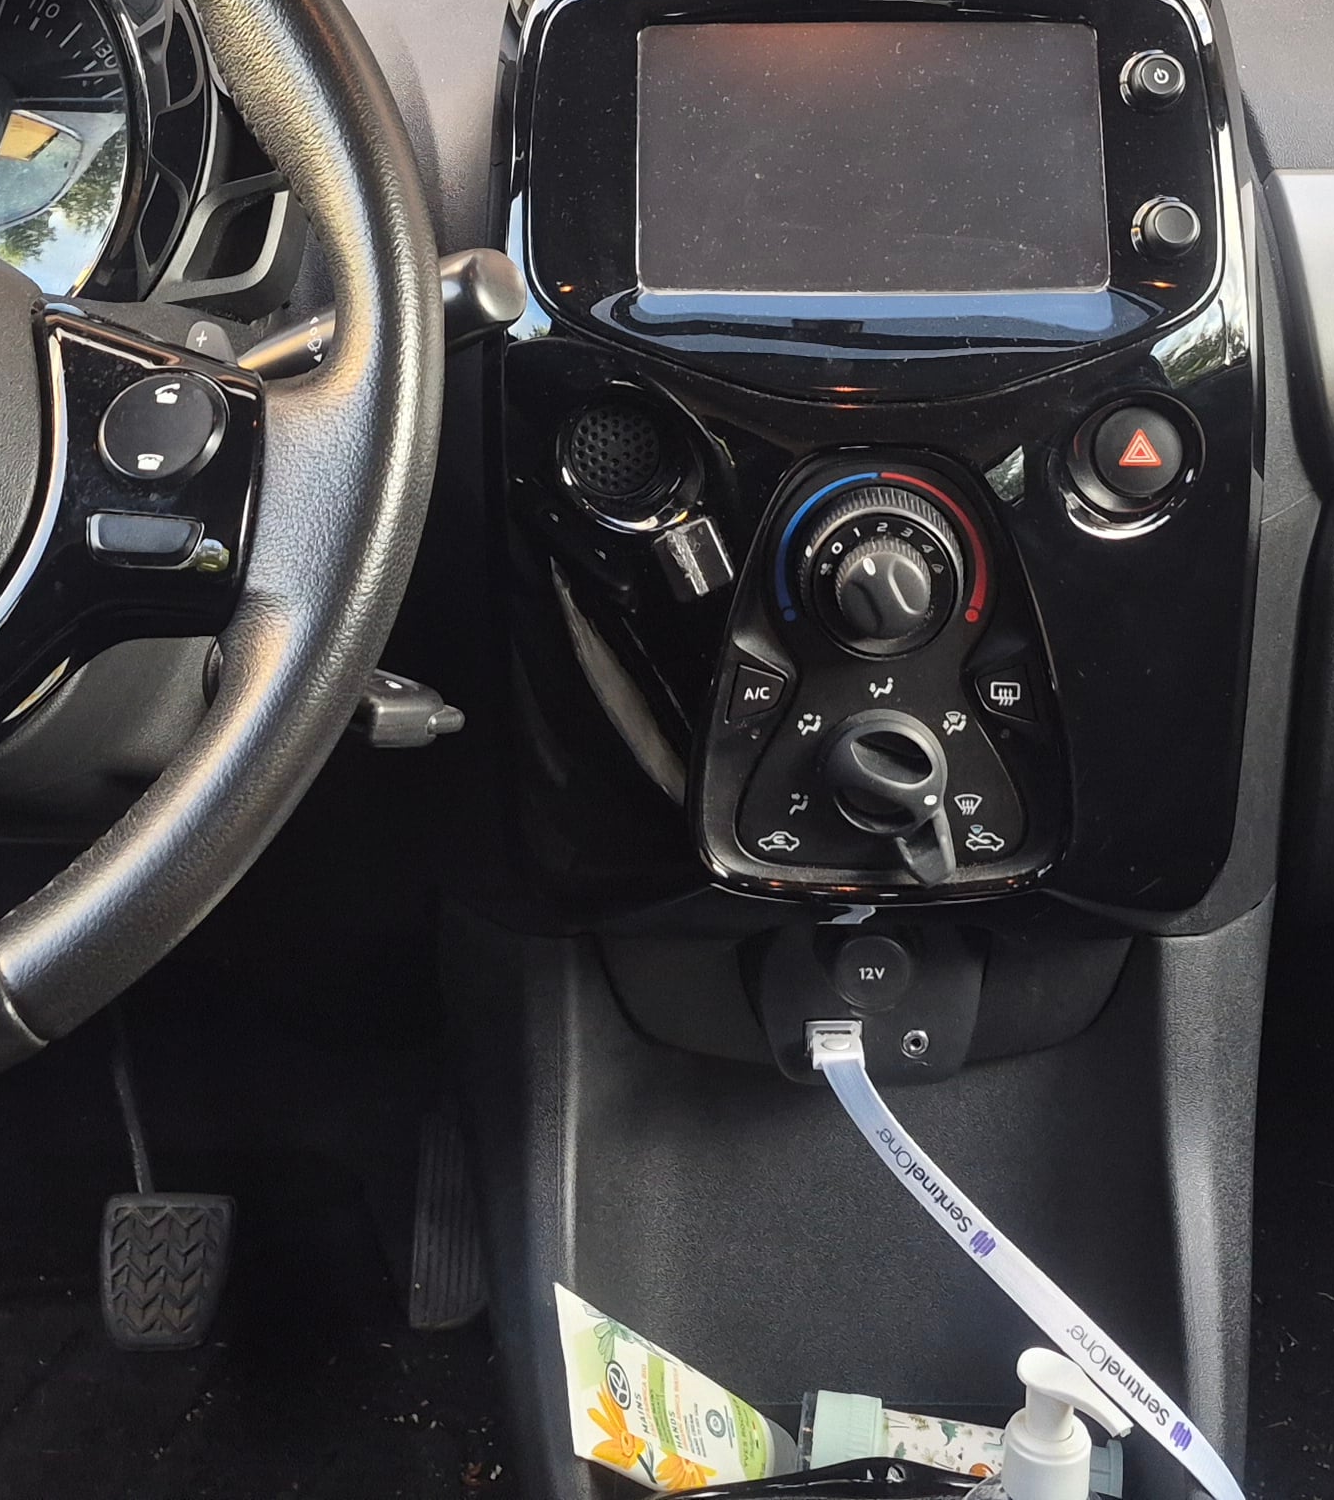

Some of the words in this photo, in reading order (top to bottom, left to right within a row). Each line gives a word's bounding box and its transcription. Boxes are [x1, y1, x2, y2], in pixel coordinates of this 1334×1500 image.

[91, 37, 117, 68] 130
[853, 527, 861, 537] 1
[876, 522, 888, 532] 2
[900, 527, 913, 538] 3
[831, 541, 843, 555] 0
[922, 544, 934, 554] 4
[744, 686, 771, 701] A/C
[858, 966, 886, 980] 12V
[877, 1128, 973, 1233] SentinelOne
[1069, 1325, 1170, 1426] SentinelOne
[634, 1392, 651, 1435] MAINS
[668, 1411, 683, 1449] HANDS
